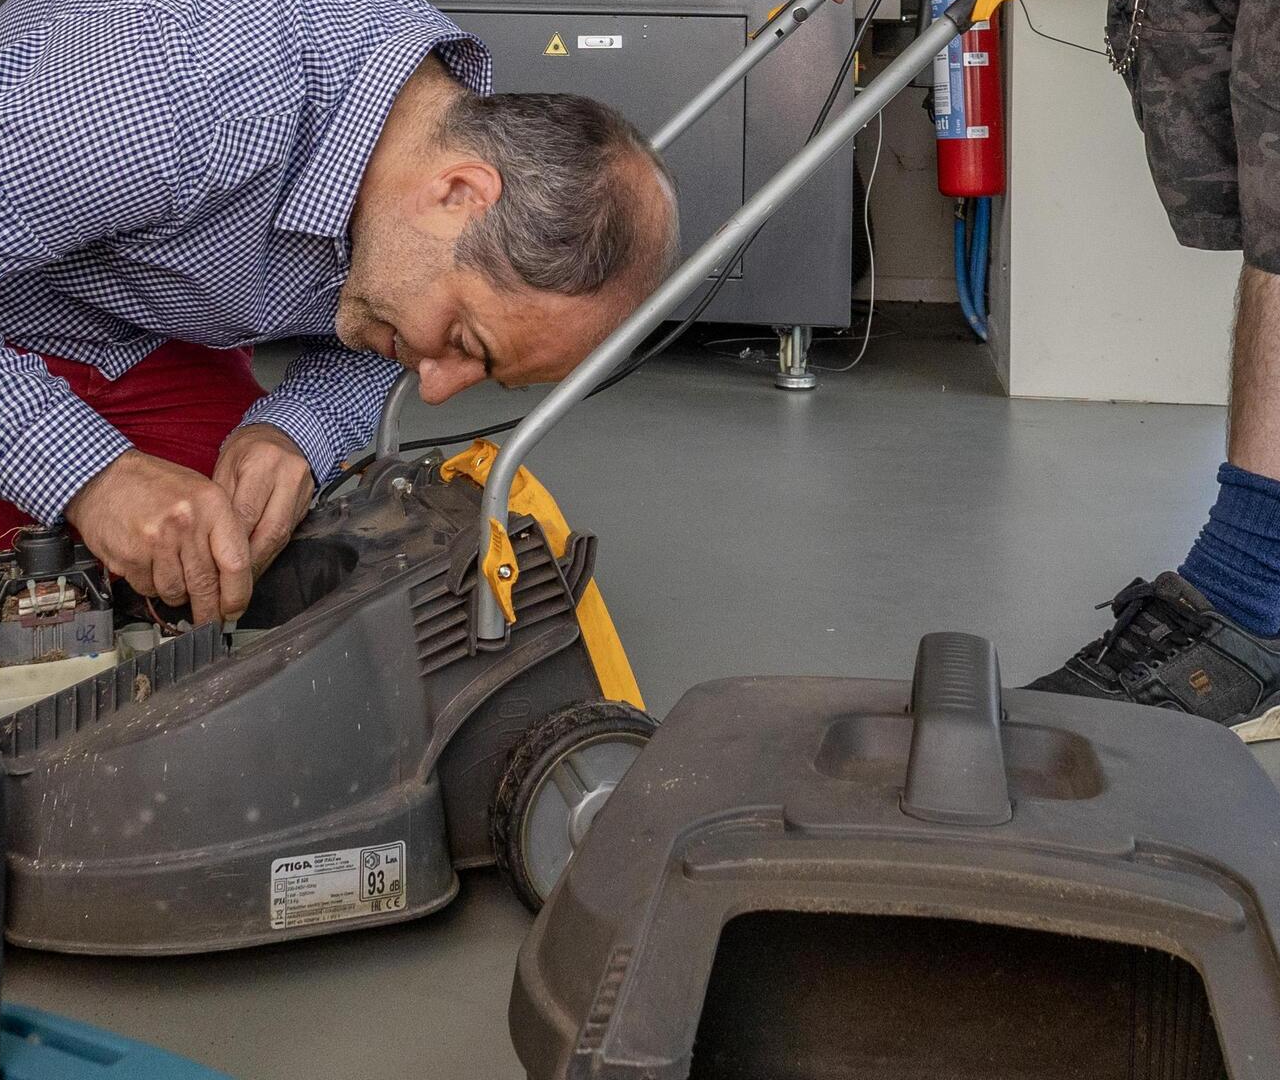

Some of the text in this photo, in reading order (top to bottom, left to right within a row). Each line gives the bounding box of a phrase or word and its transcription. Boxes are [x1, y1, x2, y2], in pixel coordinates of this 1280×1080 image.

[935, 116, 949, 130] ati
[275, 860, 312, 873] STIGA
[367, 870, 385, 896] 93
[389, 879, 400, 892] dB
